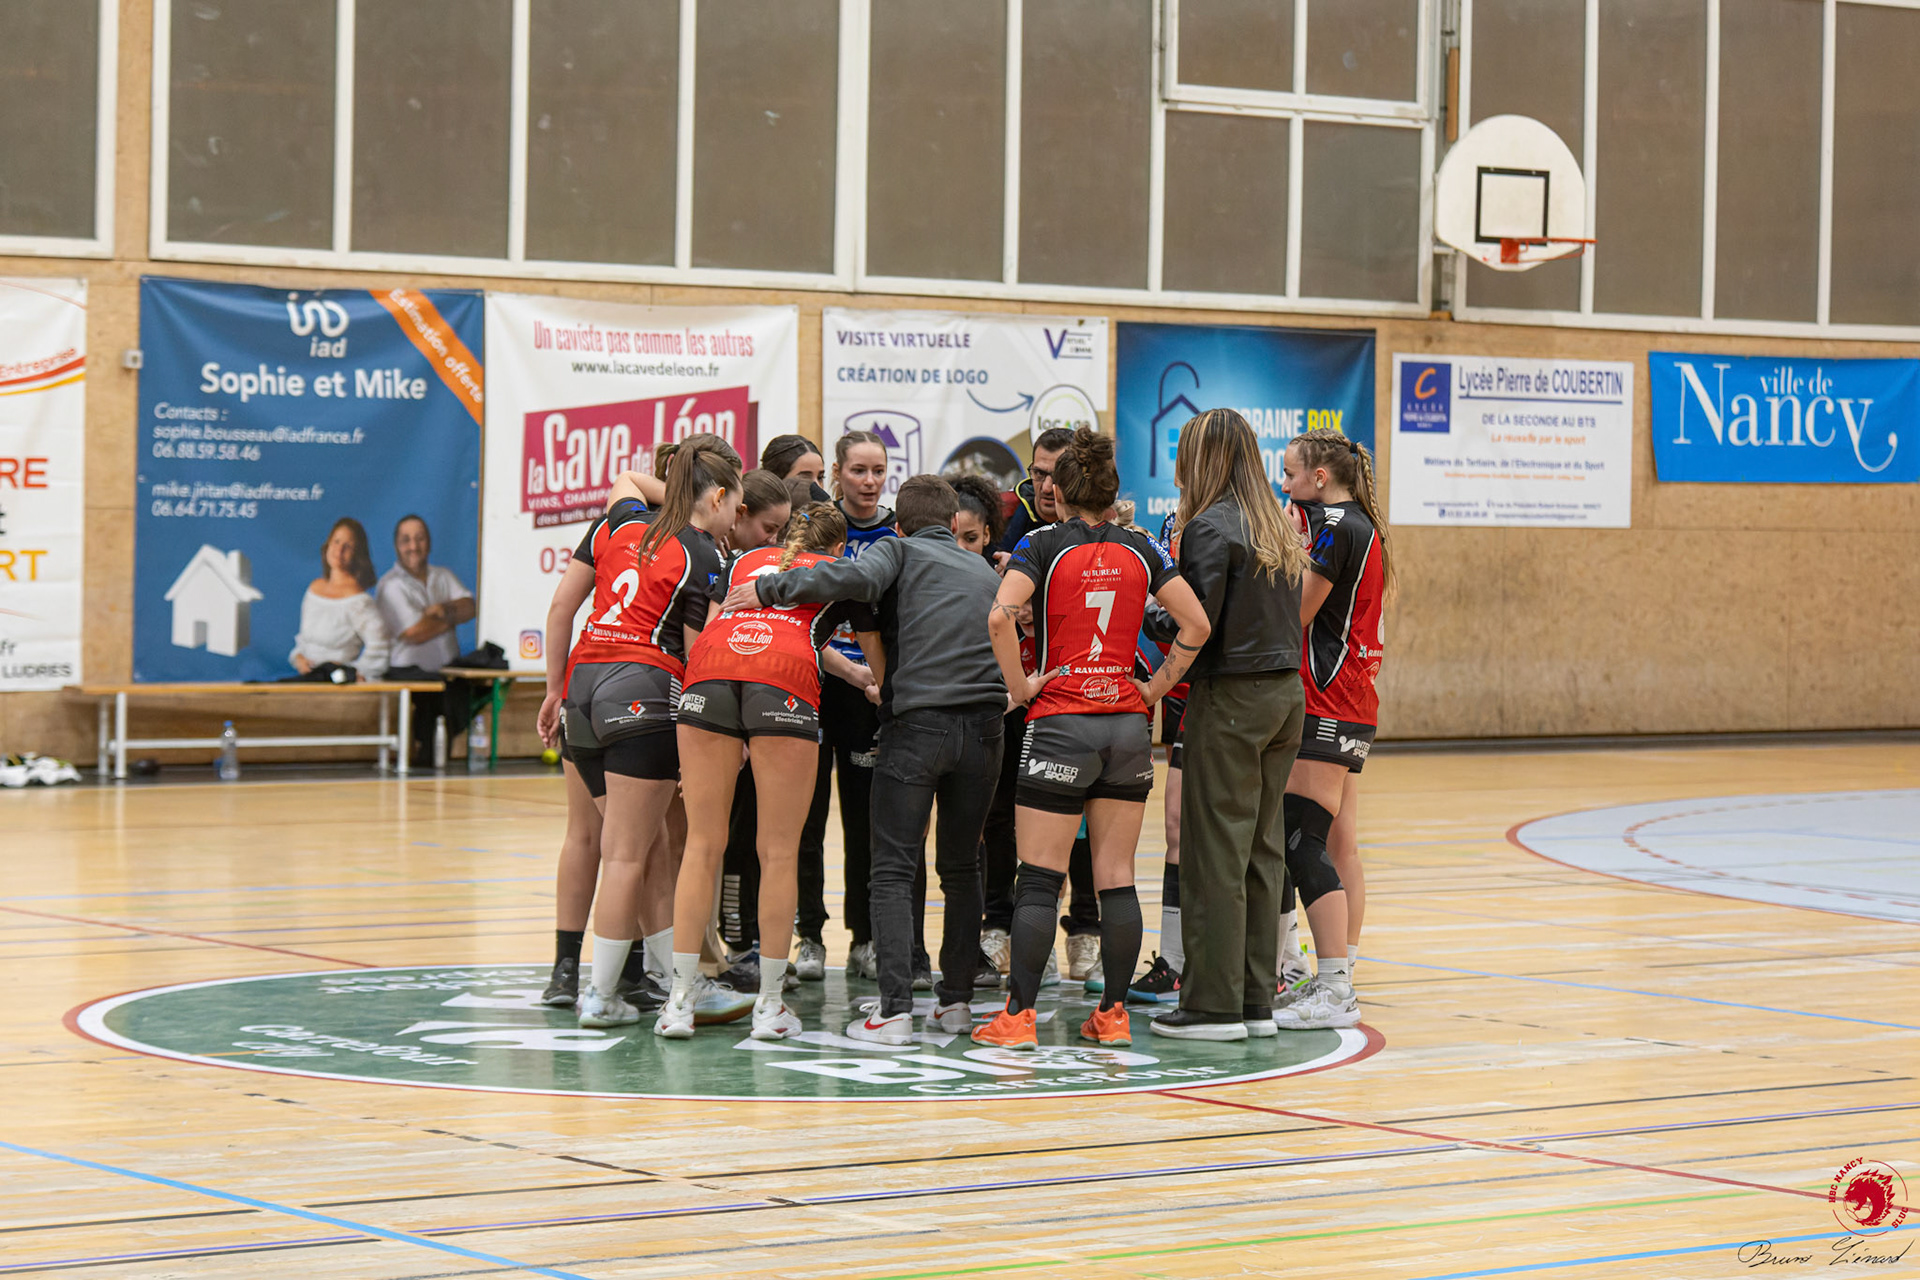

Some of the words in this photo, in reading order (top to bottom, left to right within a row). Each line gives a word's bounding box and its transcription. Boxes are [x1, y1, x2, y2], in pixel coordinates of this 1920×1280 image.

[310, 337, 347, 358] iad
[389, 287, 448, 357] Estimation
[445, 355, 485, 404] offerte
[533, 320, 552, 349] Un
[556, 324, 601, 352] caviste
[606, 331, 630, 356] pas
[633, 331, 681, 354] comme
[685, 327, 706, 355] les
[709, 329, 754, 357] autres
[836, 330, 886, 347] VISITE
[889, 331, 971, 348] VIRTUELLE
[571, 360, 720, 377] www.lacavedeleon.fr
[836, 364, 917, 383] CRÉATION
[921, 368, 941, 383] DE
[946, 369, 990, 385] LOGO
[200, 362, 306, 402] Sophie
[313, 371, 347, 398] et
[355, 368, 428, 400] Mike
[1458, 366, 1494, 397] Lycée
[1497, 367, 1531, 393] Pierre
[1534, 370, 1549, 393] de
[1552, 370, 1623, 396] COUBERTIN
[1760, 366, 1804, 395] ville
[1808, 367, 1834, 395] de
[153, 402, 218, 421] Contacts
[1482, 413, 1495, 426] DE
[1498, 414, 1510, 426] LA
[1513, 414, 1558, 427] SECONDE
[1562, 416, 1575, 428] AU
[1577, 416, 1597, 428] BTS
[1672, 361, 1898, 473] Nancy
[543, 413, 632, 494] Cave
[564, 487, 611, 506] CHAMP
[1091, 567, 1122, 577] BUREAU
[593, 568, 640, 627] 2
[767, 612, 789, 622] DEM
[1085, 591, 1116, 662] 7
[2, 662, 73, 679] LUDRES
[1074, 666, 1105, 674] RAYAN
[683, 701, 705, 714] SPORT
[684, 693, 706, 705] INTER
[1044, 771, 1077, 784] SPORT
[1047, 762, 1079, 776] INTER
[240, 1024, 480, 1066] Carrefour
[908, 1065, 1231, 1094] Carrefour
